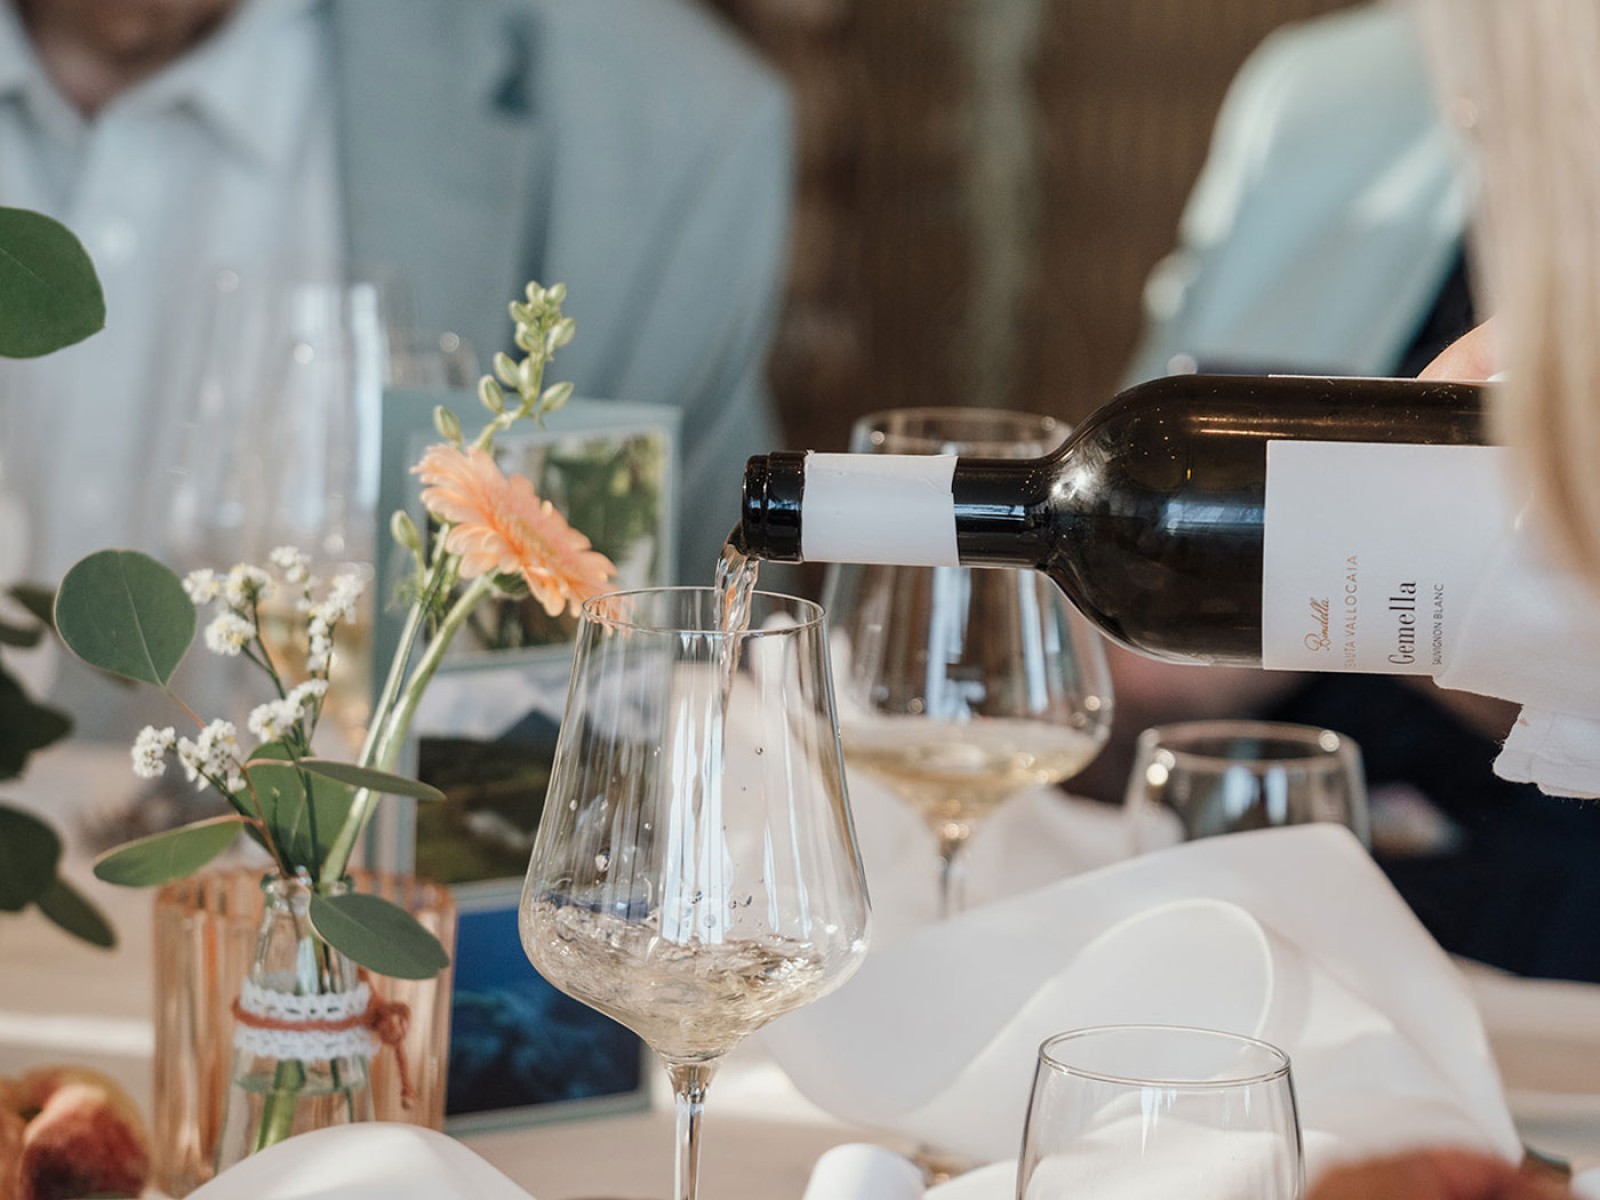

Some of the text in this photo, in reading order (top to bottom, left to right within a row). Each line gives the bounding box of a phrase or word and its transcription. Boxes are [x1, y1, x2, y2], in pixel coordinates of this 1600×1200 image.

[1344, 555, 1358, 638] VALLOCAIA
[1388, 581, 1417, 665] Gemella
[1432, 584, 1444, 665] SAUVIGNON BLANC
